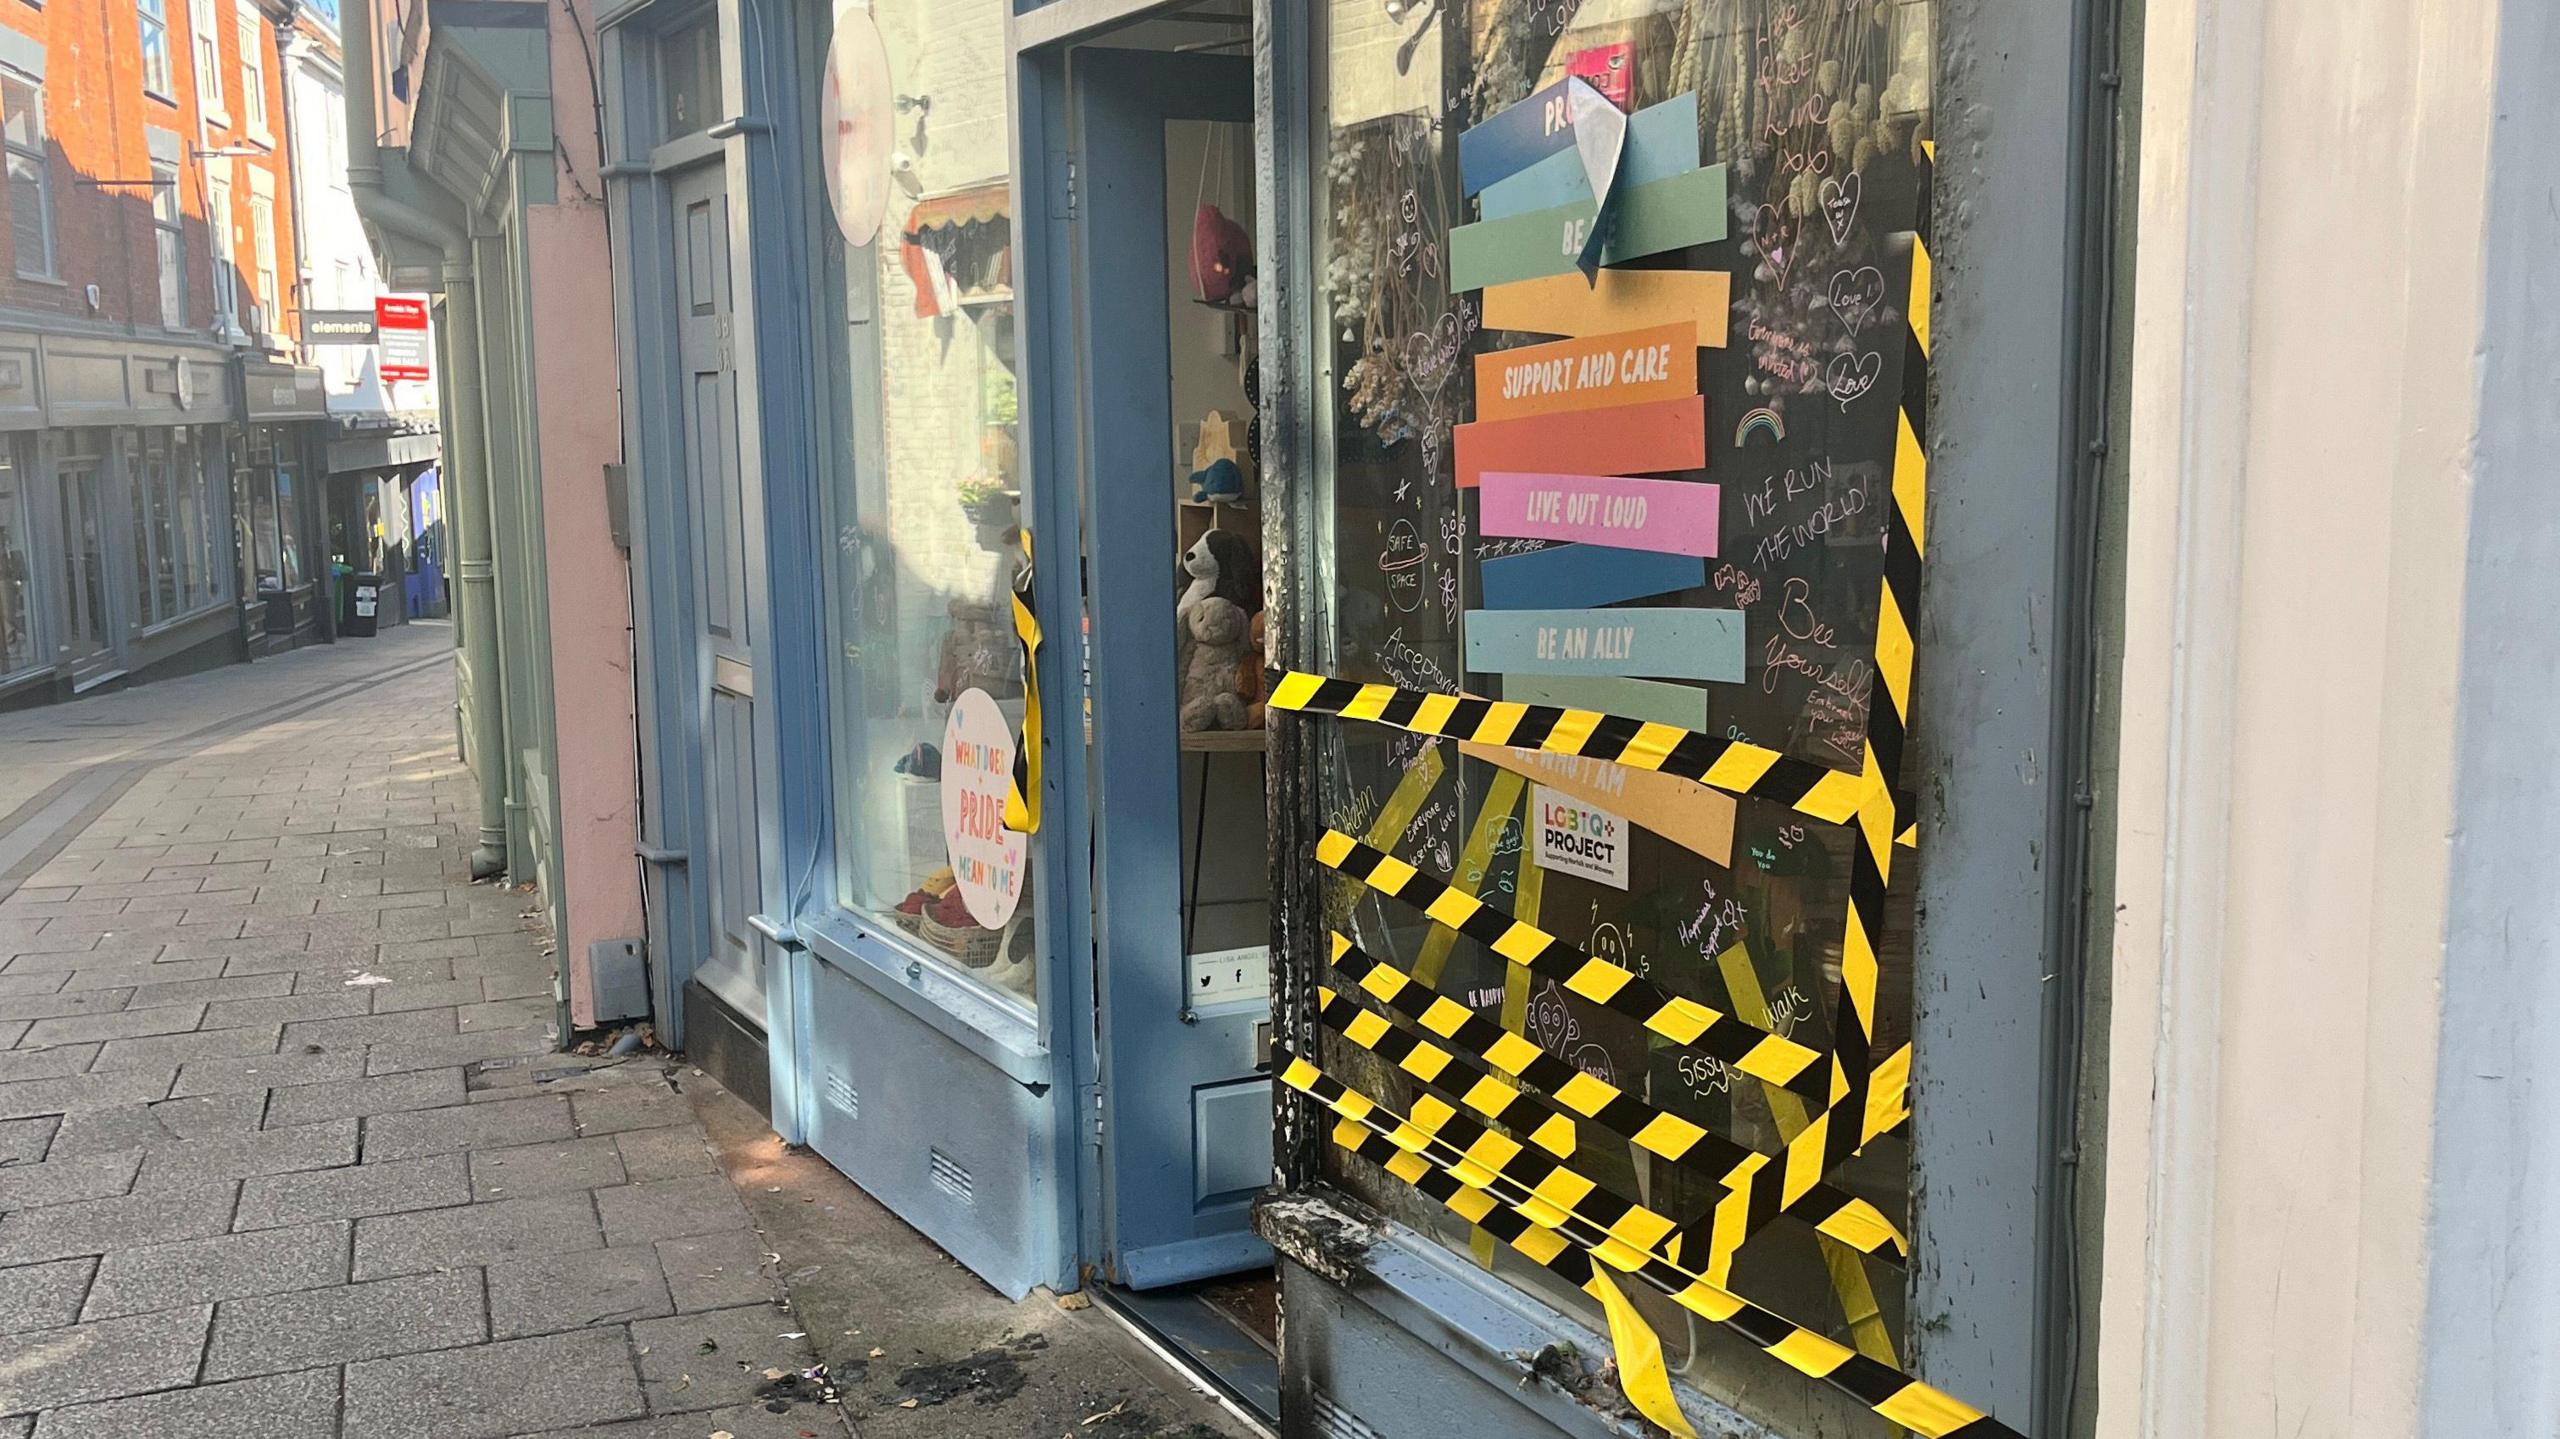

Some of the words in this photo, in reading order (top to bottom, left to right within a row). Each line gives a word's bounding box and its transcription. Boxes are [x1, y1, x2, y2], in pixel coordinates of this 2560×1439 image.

[1545, 95, 1578, 137] PRO
[1562, 218, 1585, 256] BE
[311, 320, 372, 334] elements
[1503, 357, 1574, 399] SUPPORT
[1576, 351, 1616, 389] AND
[1620, 344, 1670, 384] CARE
[1832, 363, 1870, 395] Love
[1527, 490, 1562, 524] LIVE
[1567, 492, 1599, 526] OUT
[1603, 495, 1648, 529] LOUD
[1743, 475, 1777, 527] WE
[1783, 455, 1832, 502] RUN
[1752, 525, 1791, 572] THE
[1792, 474, 1872, 548] WORLD!
[1389, 534, 1413, 552] SAFE
[1391, 573, 1417, 589] SPACE
[1537, 626, 1557, 660] BE
[1563, 627, 1588, 661] AN
[1593, 626, 1634, 661] ALLY
[1763, 634, 1874, 720] Yourself
[955, 739, 981, 770] WHAT
[983, 744, 1006, 776] DOES
[1594, 762, 1627, 797] AM
[959, 788, 1005, 846] PRIDE
[1544, 802, 1615, 838] LGBTQ+
[1545, 829, 1615, 864] PROJECT
[958, 855, 984, 888] MEAN
[987, 863, 998, 890] TO
[1000, 866, 1014, 898] ME
[1761, 985, 1809, 1030] Walk
